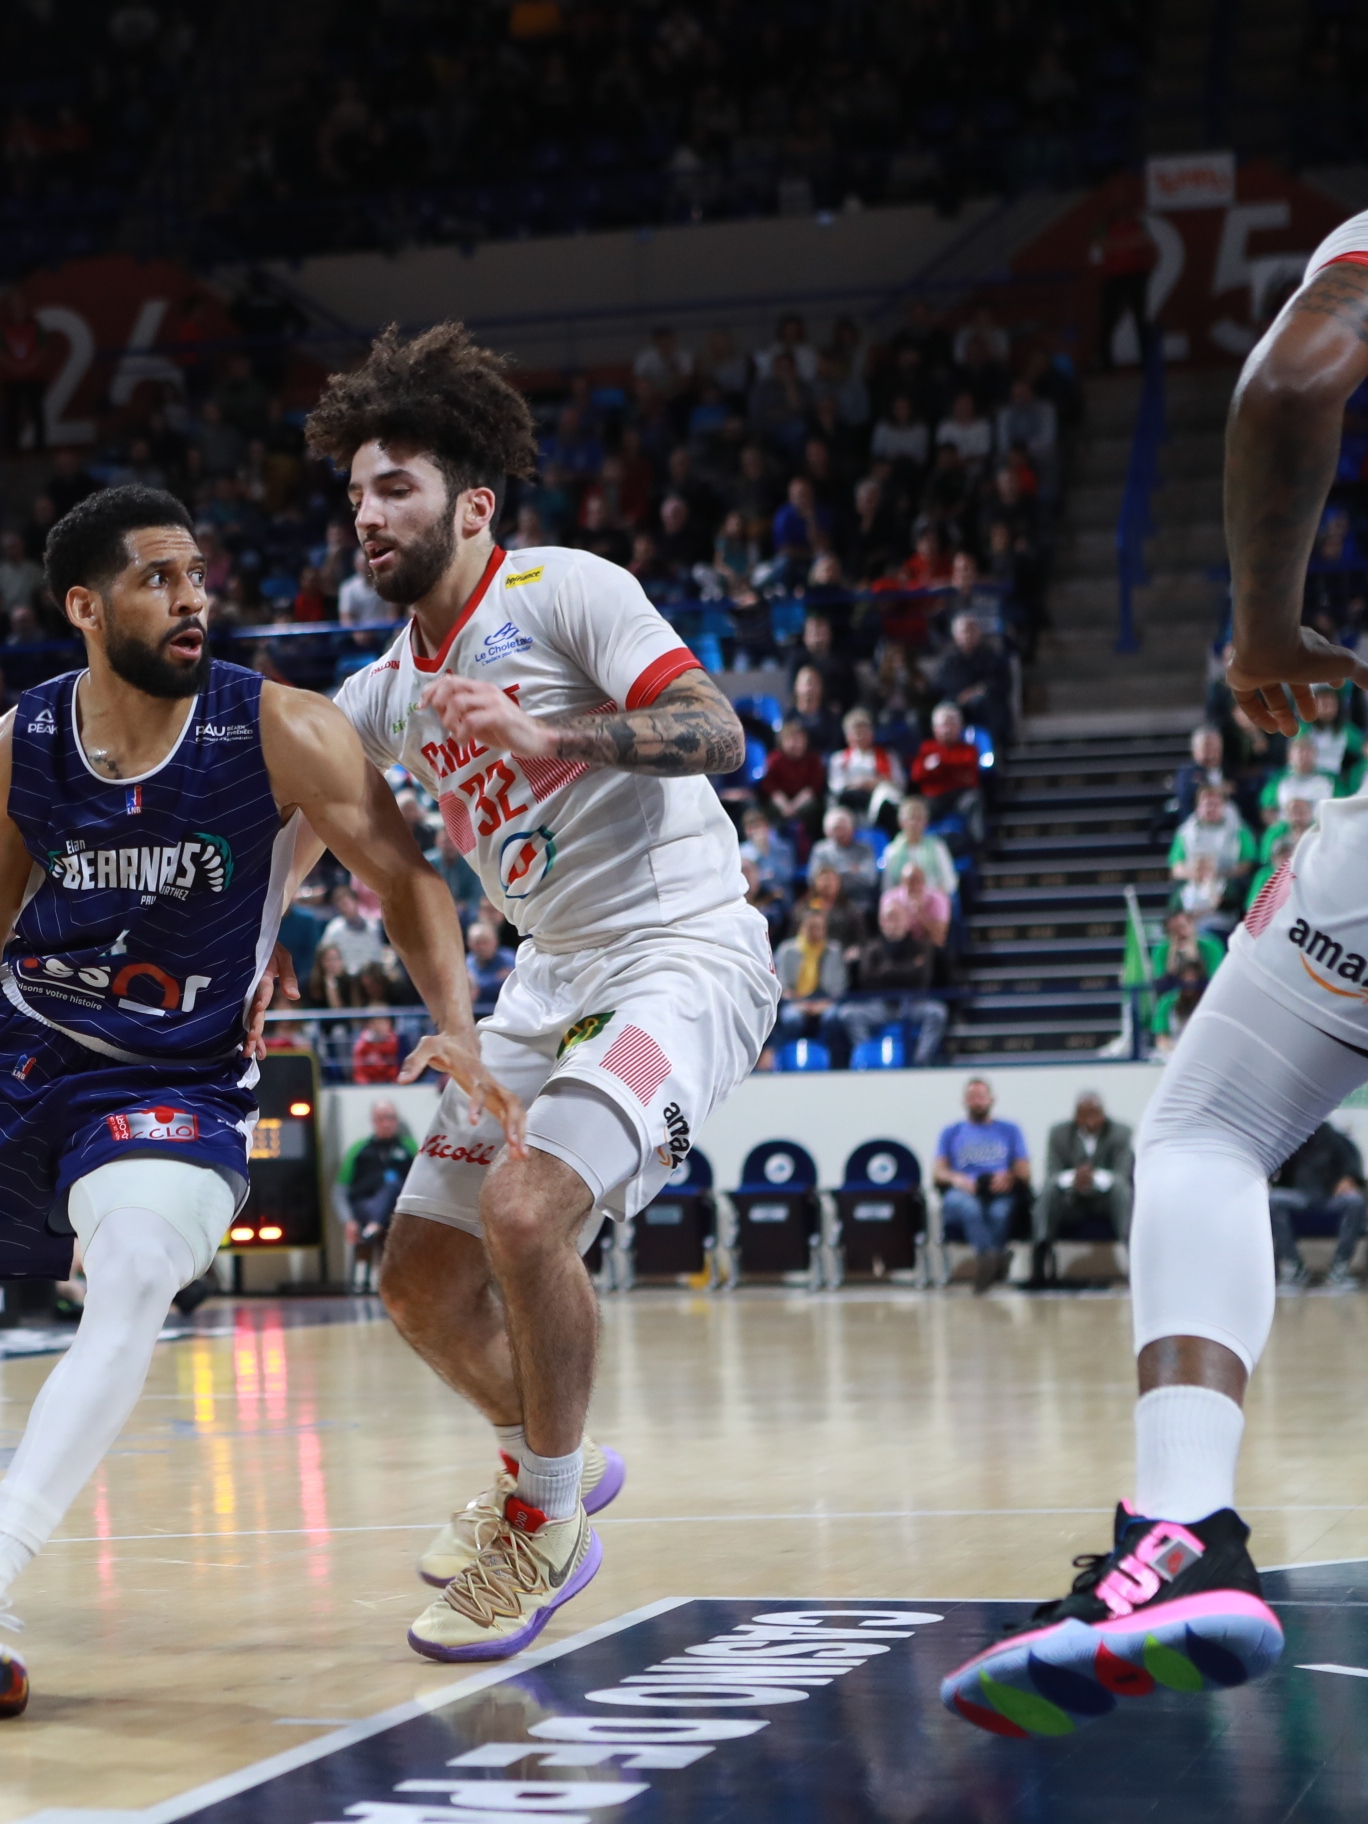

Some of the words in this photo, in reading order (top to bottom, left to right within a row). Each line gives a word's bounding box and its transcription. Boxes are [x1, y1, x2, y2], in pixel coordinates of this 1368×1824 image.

[475, 653, 486, 662] Le
[28, 723, 58, 735] PEAK
[195, 722, 226, 737] PAU
[459, 759, 528, 837] 32
[127, 806, 141, 815] LNB
[1288, 917, 1368, 987] ama
[45, 988, 68, 1001] votre
[70, 995, 102, 1010] histoire
[585, 1610, 945, 1707] CASINO
[446, 1716, 772, 1769] DE
